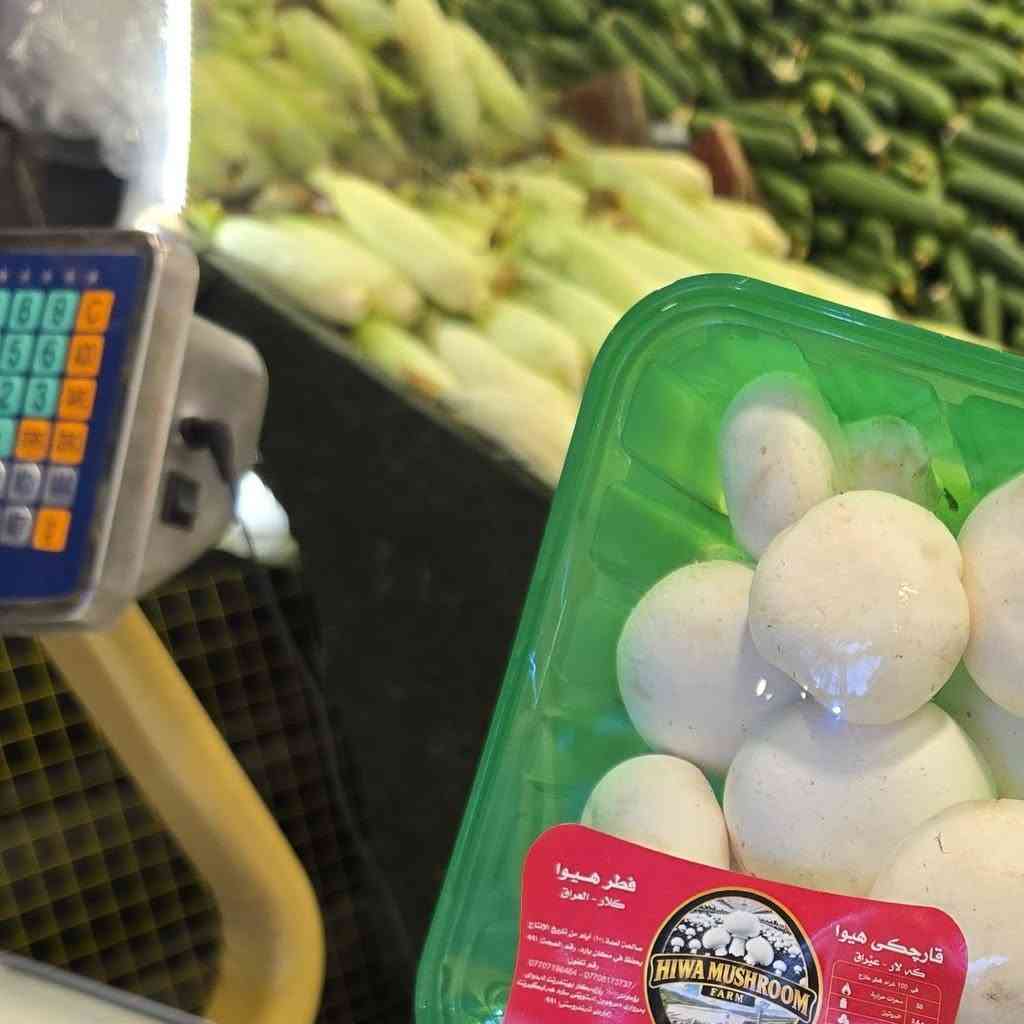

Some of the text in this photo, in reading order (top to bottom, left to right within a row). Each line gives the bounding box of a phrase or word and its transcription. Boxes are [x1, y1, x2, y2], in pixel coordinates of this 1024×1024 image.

[555, 863, 637, 892] فطر هيوا
[560, 887, 590, 901] العراق
[654, 959, 811, 1016] HIWA MUSHROOM
[710, 989, 744, 1003] FARM
